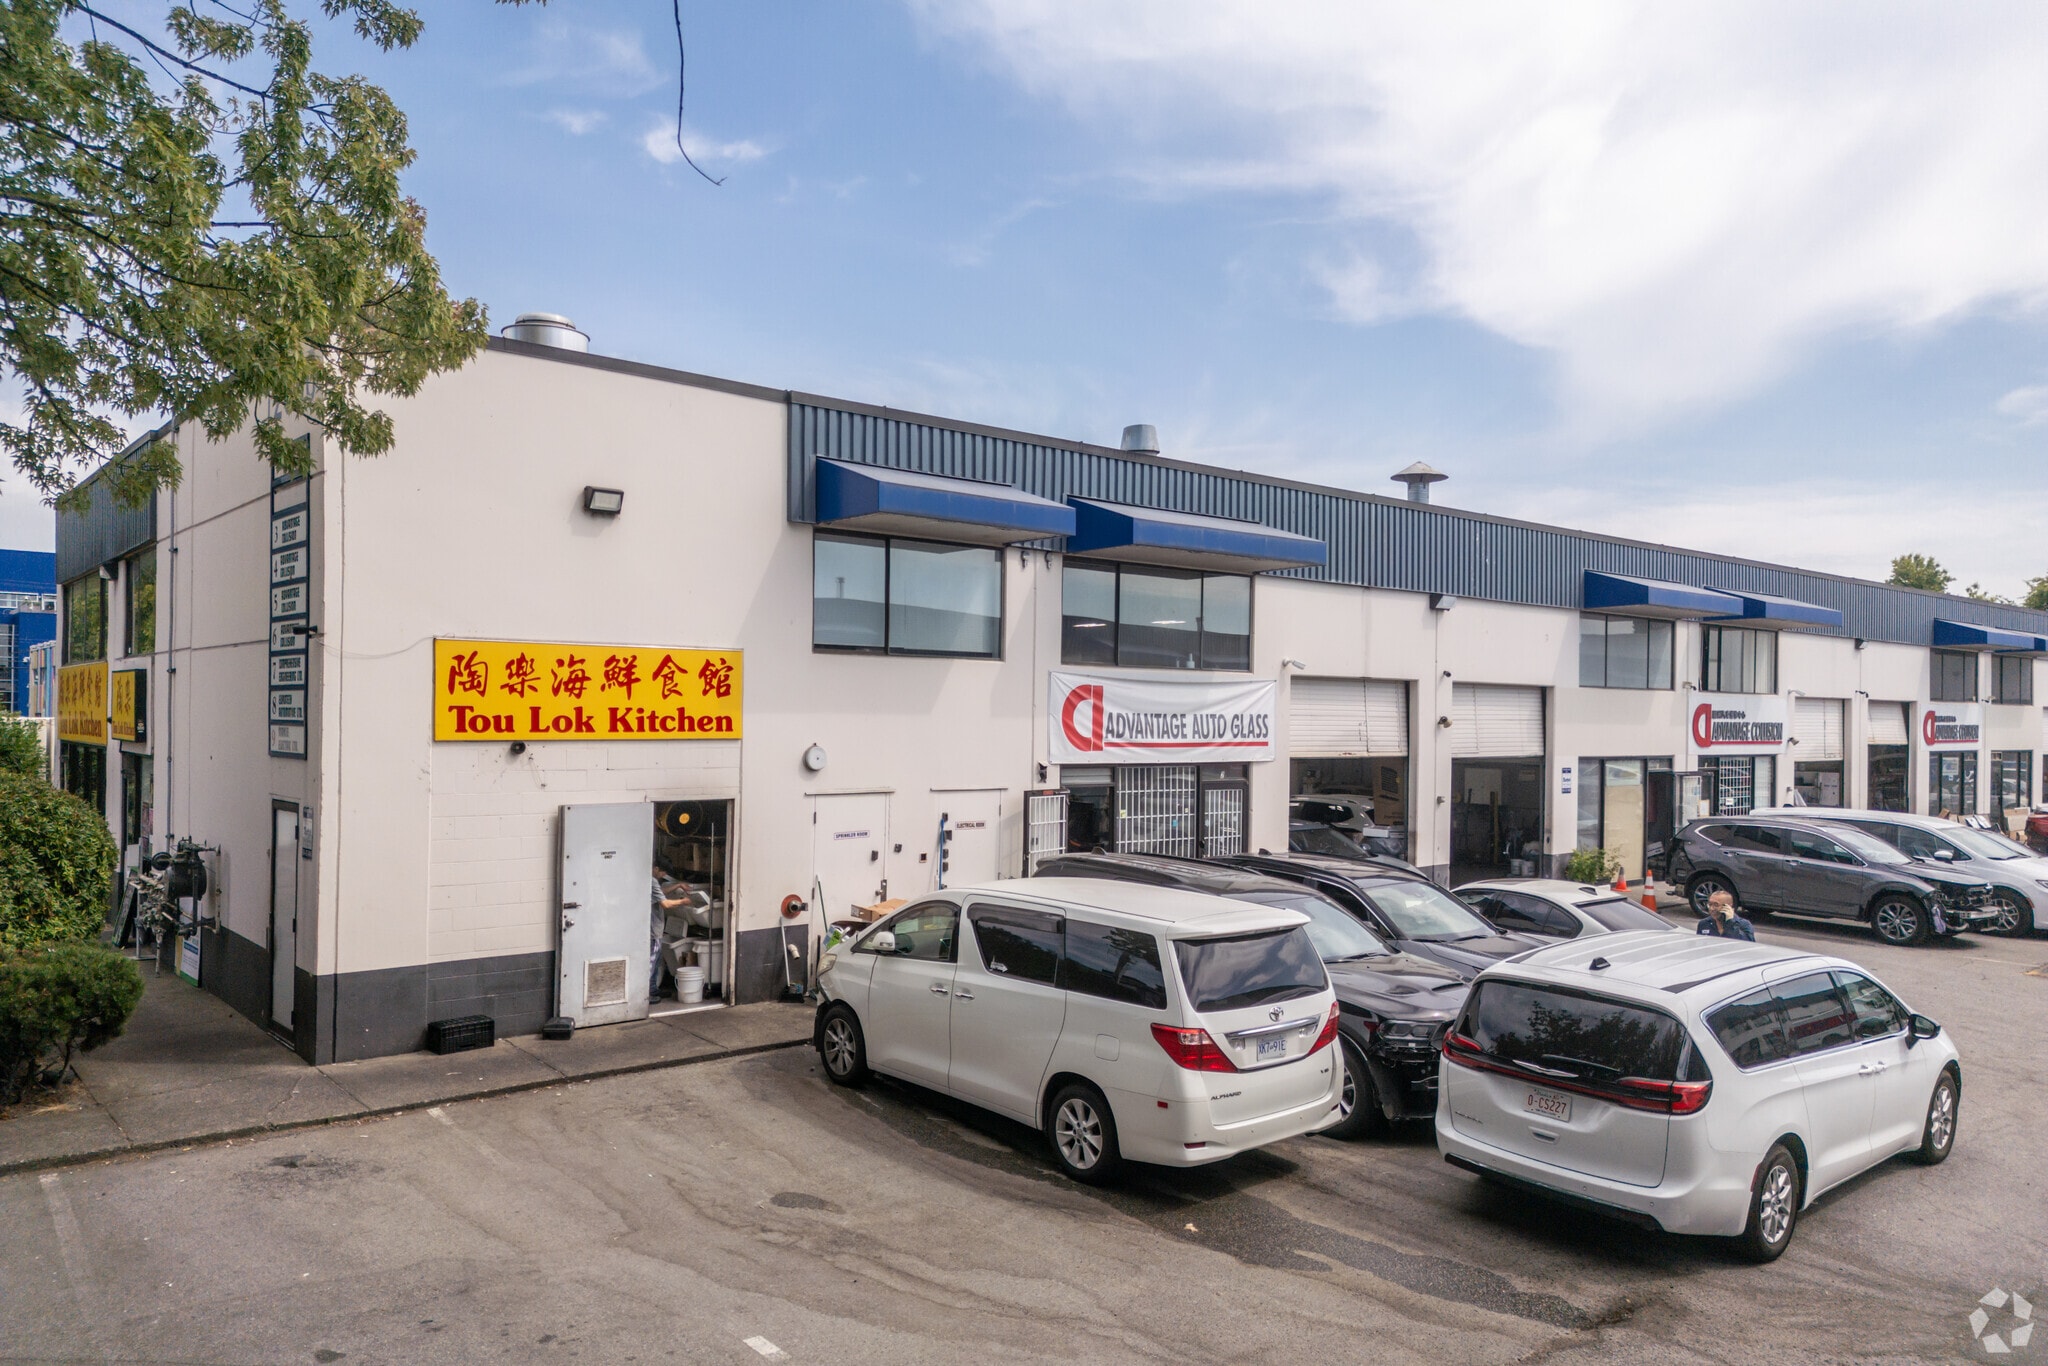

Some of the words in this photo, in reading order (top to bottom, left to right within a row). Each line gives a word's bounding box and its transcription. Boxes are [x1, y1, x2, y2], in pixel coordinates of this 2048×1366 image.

[274, 526, 279, 543] 3
[273, 560, 278, 577] 4
[274, 594, 278, 611] 5
[273, 627, 277, 645] 6
[448, 650, 735, 700] 陶樂海鮮食館
[272, 696, 277, 715] 8
[448, 705, 515, 733] Tou
[529, 706, 596, 733] Lok
[607, 706, 734, 734] Kitchen
[1105, 711, 1187, 740] ADVANTAGE
[1192, 713, 1226, 740] AUTO
[1230, 713, 1269, 739] GLASS
[1712, 722, 1750, 740] ADVANTAGE
[1751, 722, 1783, 741] COLLISION
[835, 831, 856, 839] SPRINKLER
[1210, 1091, 1242, 1101] ALPHARD
